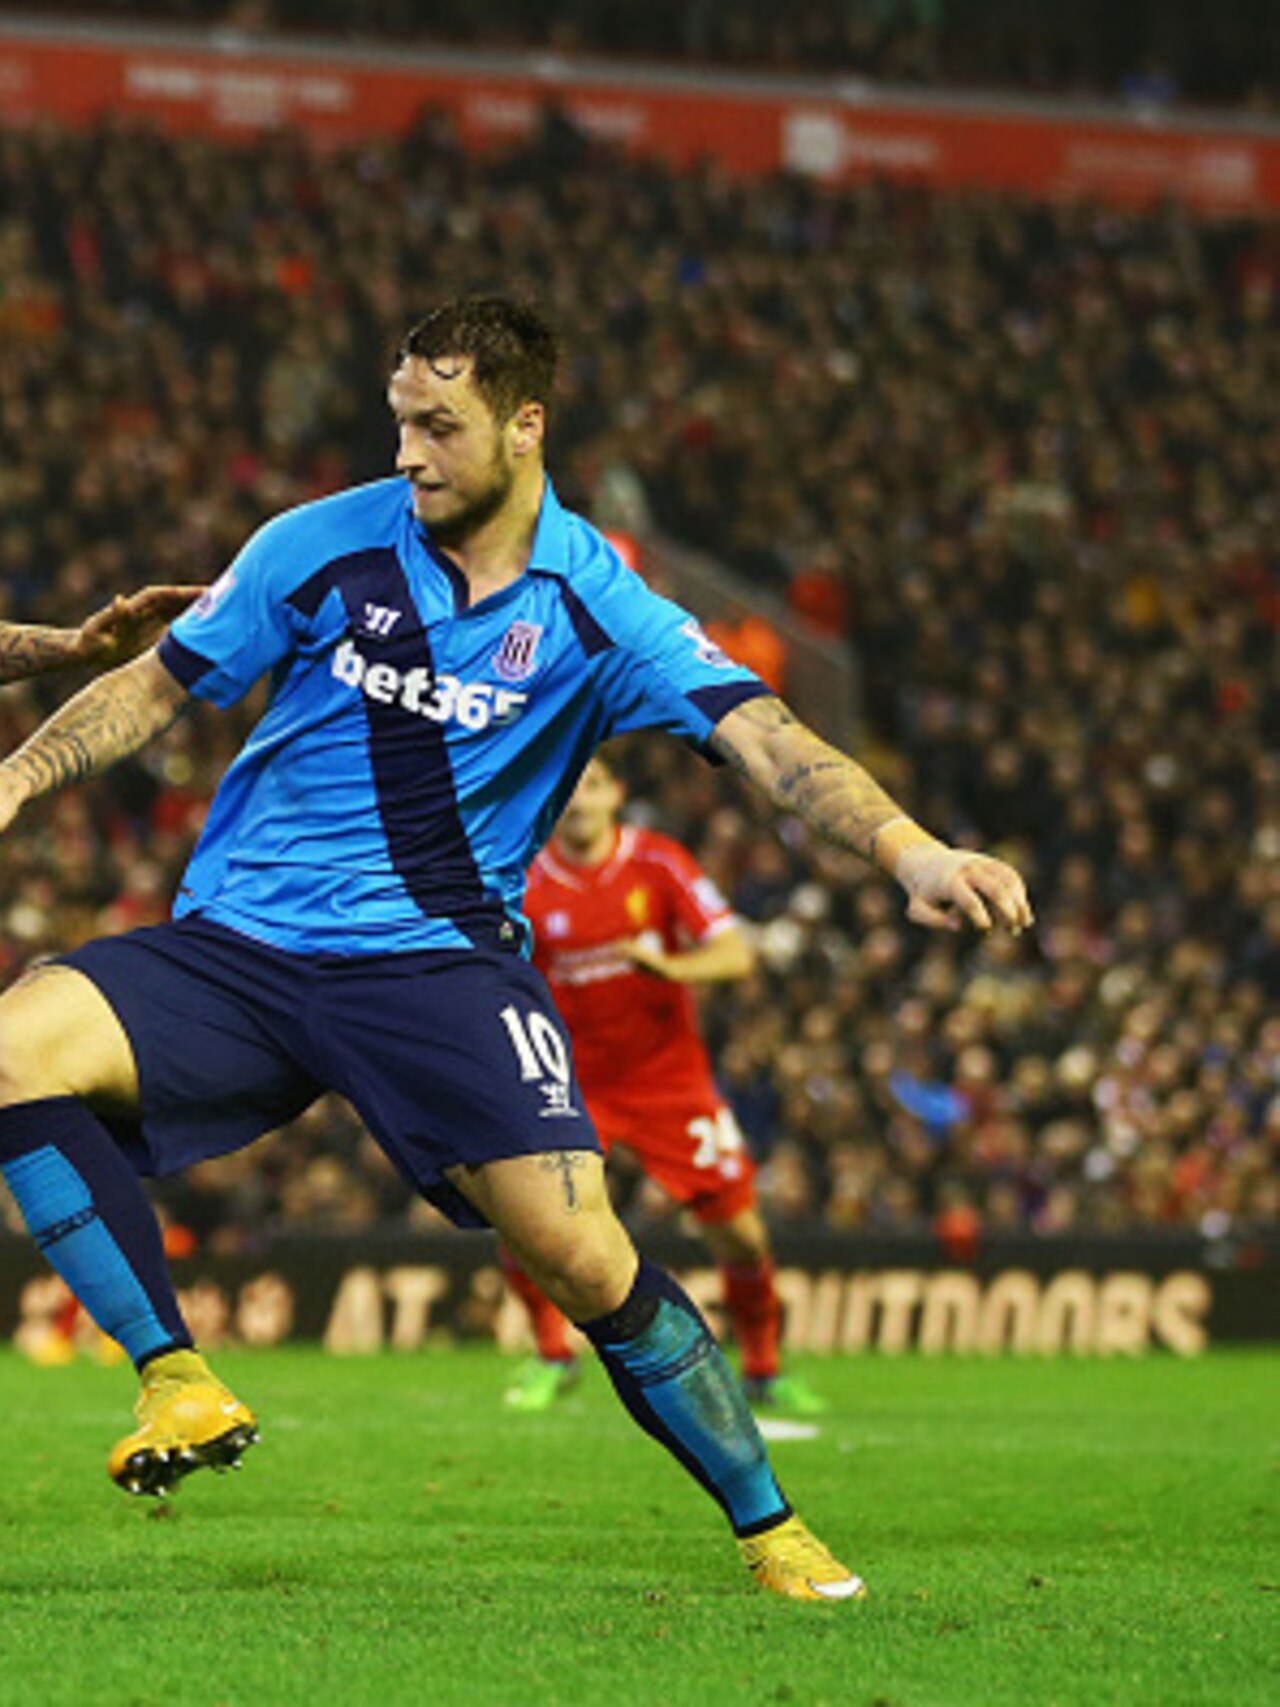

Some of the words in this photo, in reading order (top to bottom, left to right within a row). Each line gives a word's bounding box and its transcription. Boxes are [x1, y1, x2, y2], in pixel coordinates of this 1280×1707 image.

[331, 639, 529, 731] bet365
[499, 1003, 570, 1084] 10
[322, 1266, 448, 1357] AT
